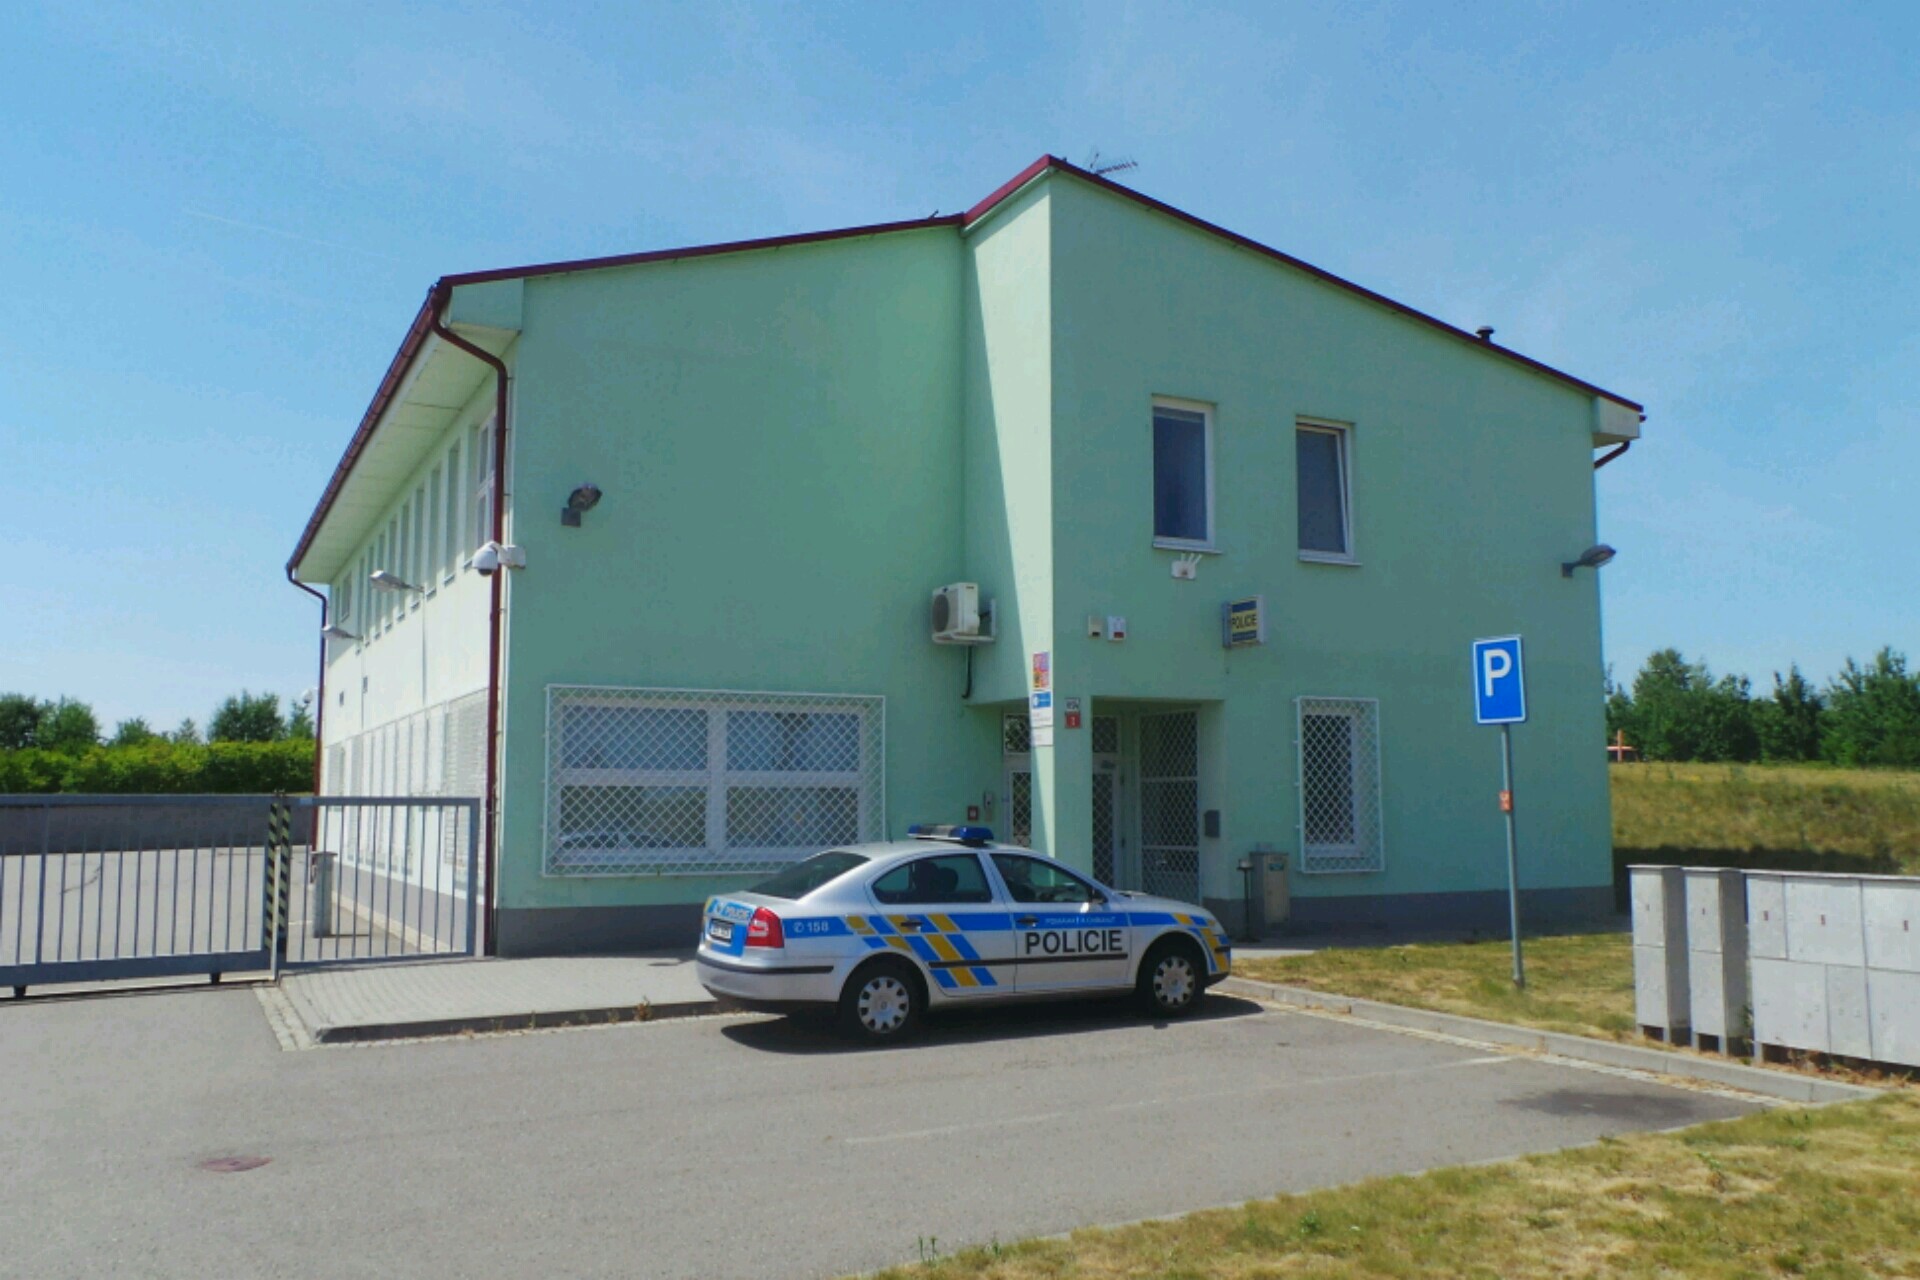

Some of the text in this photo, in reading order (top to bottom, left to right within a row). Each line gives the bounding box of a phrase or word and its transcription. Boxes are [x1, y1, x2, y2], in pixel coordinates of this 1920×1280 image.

[1231, 614, 1258, 629] POLICIE
[1483, 648, 1512, 697] P
[807, 922, 829, 933] 158
[1025, 930, 1123, 954] POLICIE
